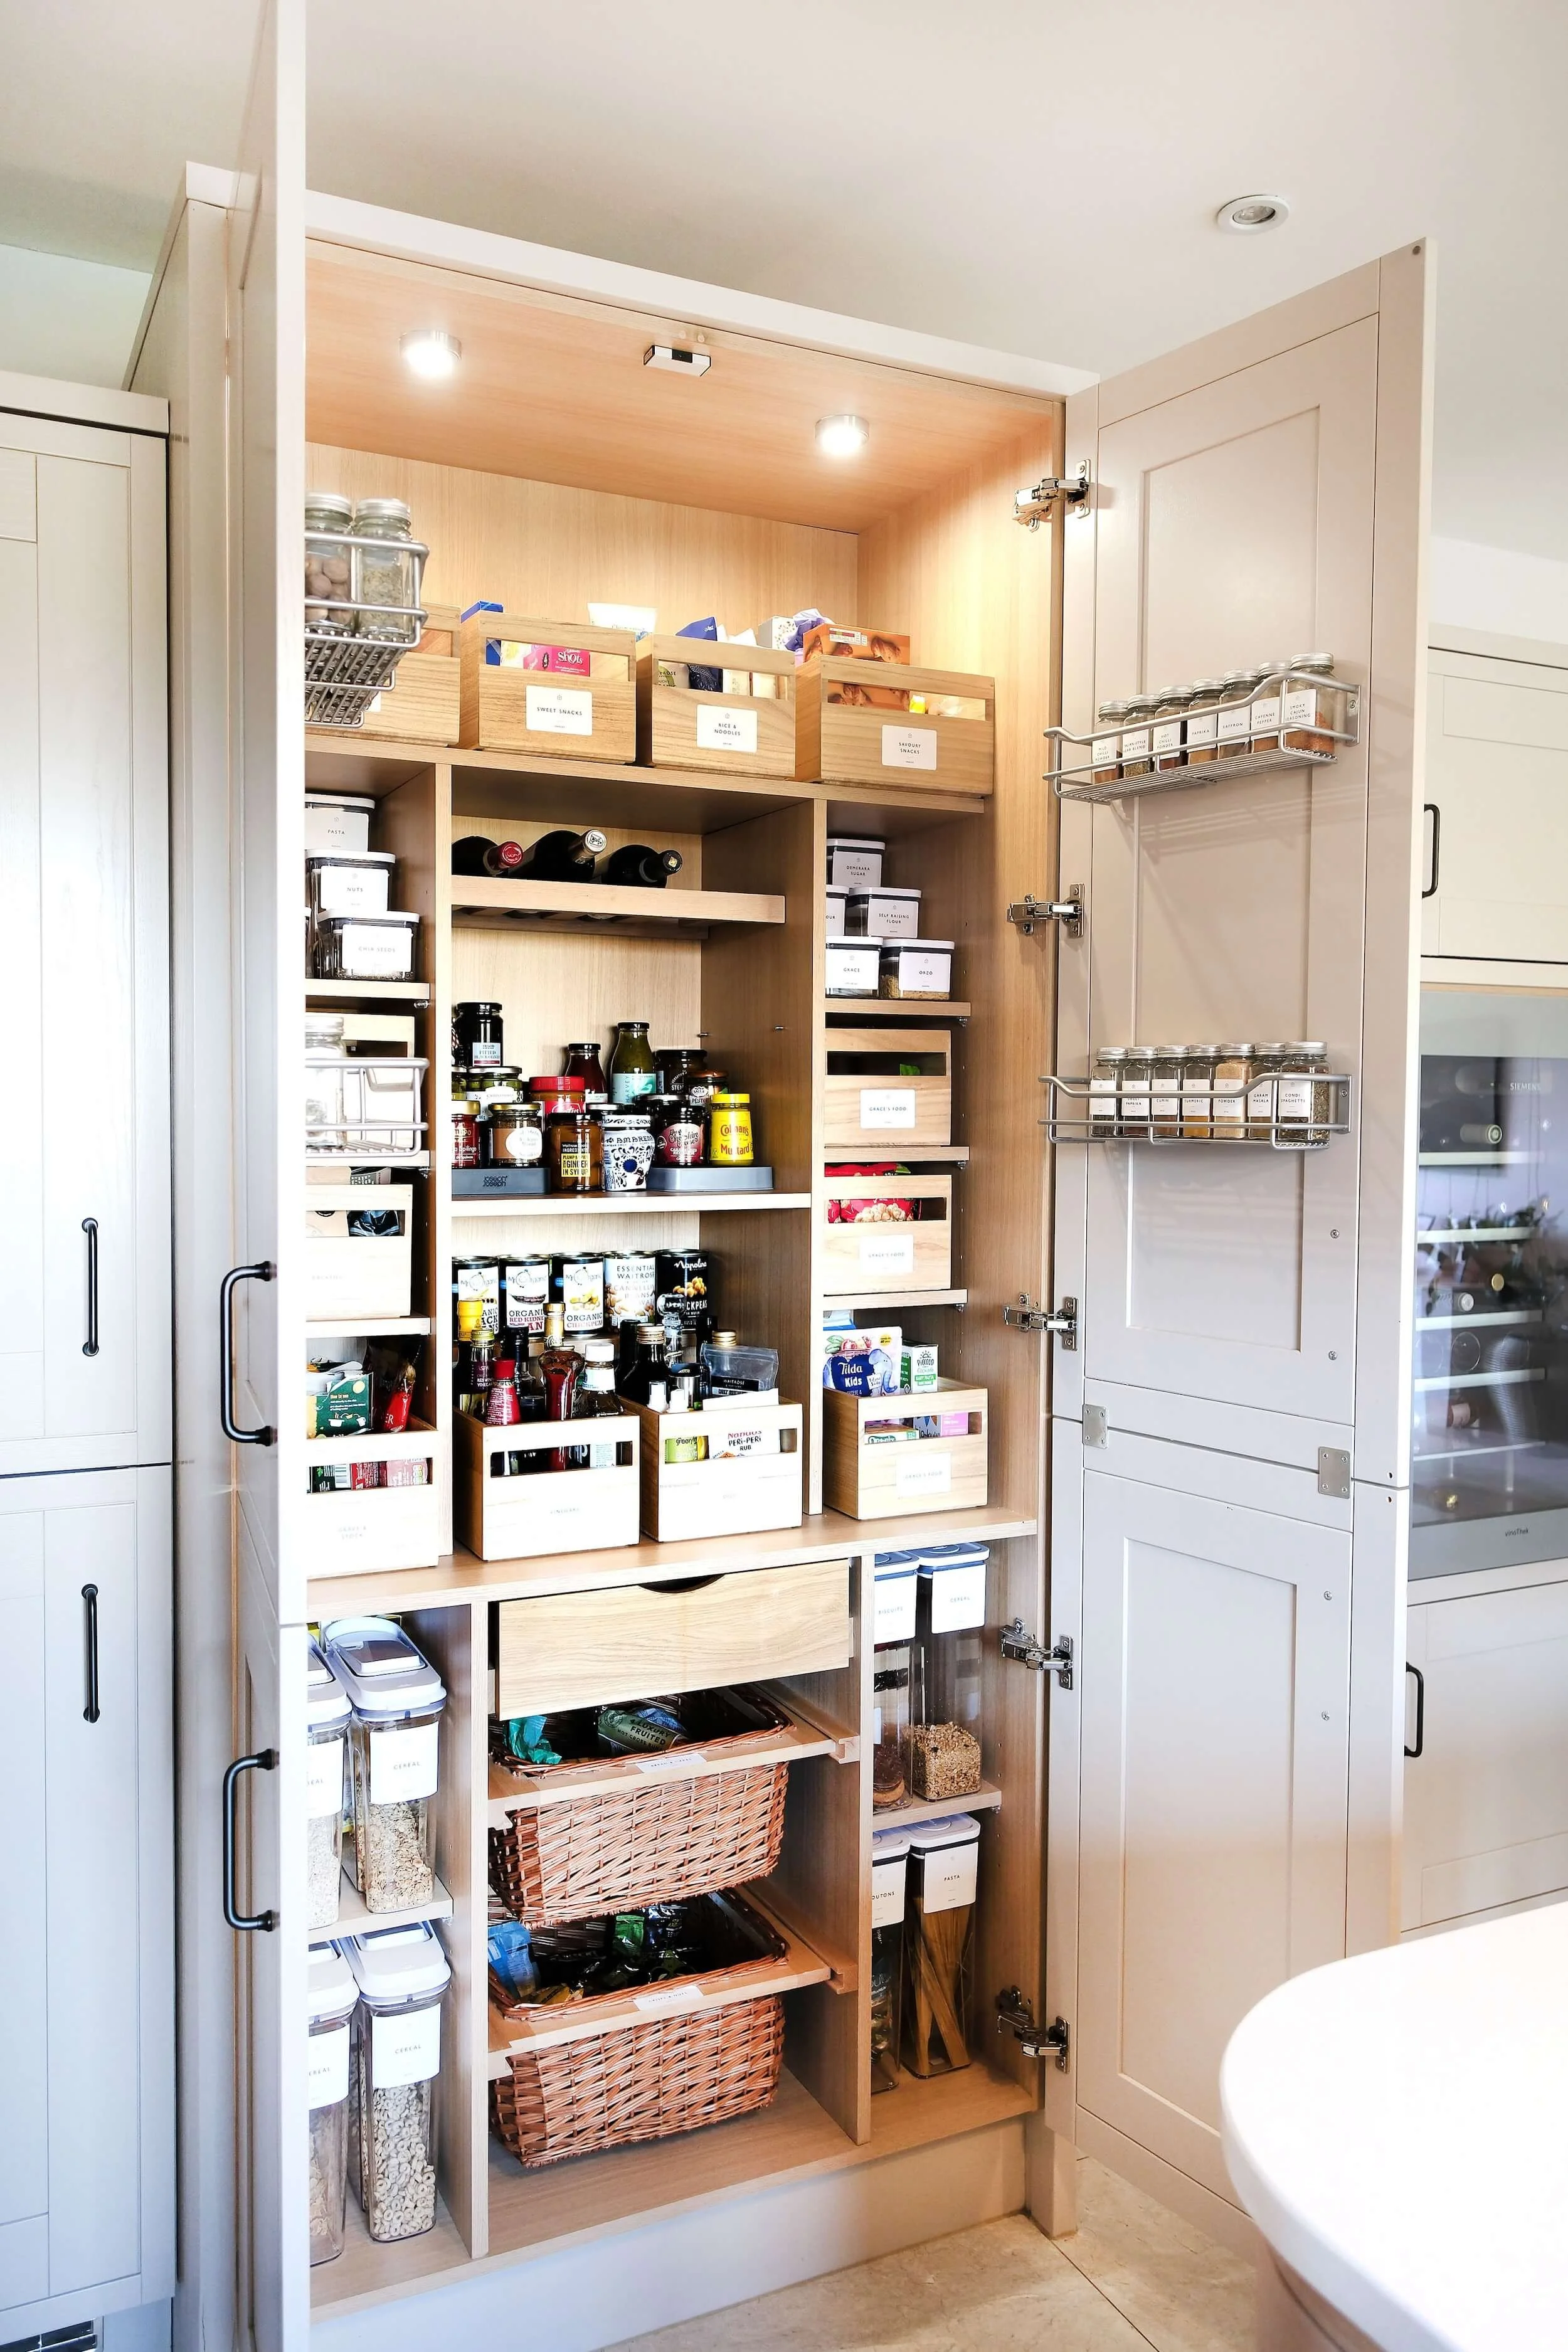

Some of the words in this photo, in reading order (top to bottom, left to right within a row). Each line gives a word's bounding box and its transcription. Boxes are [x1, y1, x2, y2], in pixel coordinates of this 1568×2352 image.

[1254, 712, 1275, 720] CAYENNE
[1510, 1082, 1542, 1091] SIEMENS
[721, 1143, 750, 1155] Mutard
[686, 1300, 707, 1310] CKPEAS
[482, 1307, 499, 1316] ANIC
[509, 1309, 544, 1317] ORGANI
[566, 1311, 603, 1322] ORGANIC
[481, 1315, 499, 1325] ACK
[838, 1362, 863, 1375] Tilda
[845, 1377, 862, 1388] Kids
[617, 1729, 628, 1737] HOT
[637, 1719, 672, 1738] LUXURY
[630, 1725, 666, 1744] FRUITED
[393, 1761, 421, 1771] CEREAL
[872, 1890, 896, 1900] OUTONS
[395, 2043, 422, 2054] CEREAL
[309, 2067, 331, 2077] EREAL
